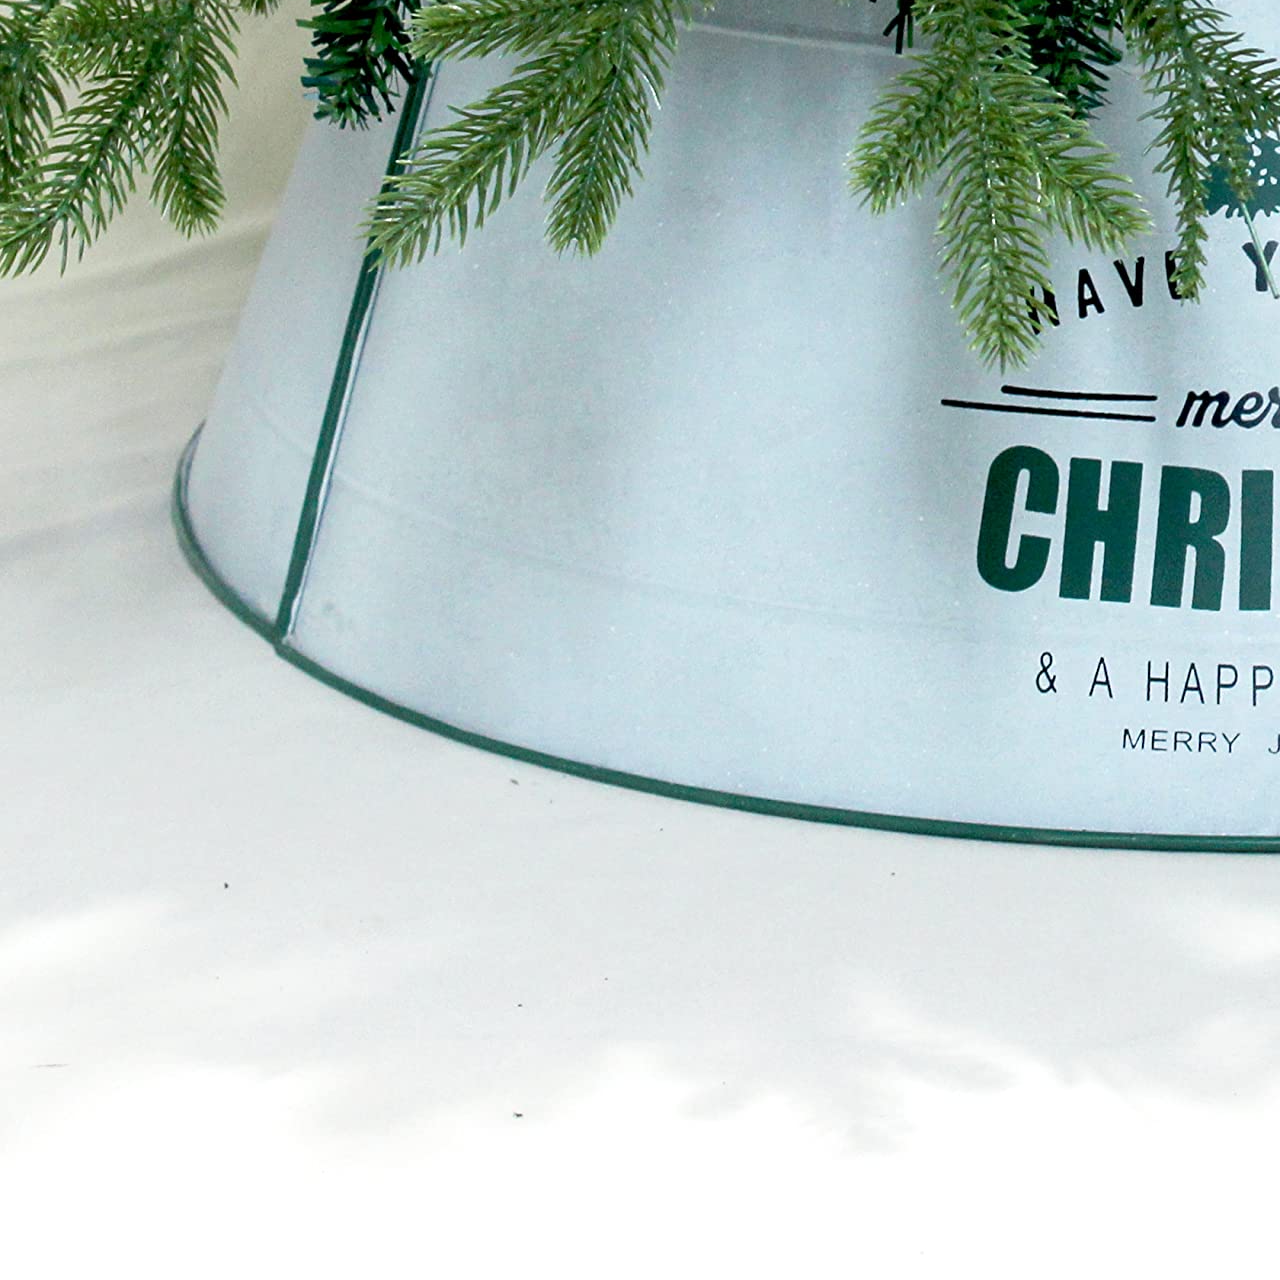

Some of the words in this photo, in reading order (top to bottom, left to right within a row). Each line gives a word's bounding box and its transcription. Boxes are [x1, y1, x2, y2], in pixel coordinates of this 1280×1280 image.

[1035, 650, 1058, 694] &
[1088, 656, 1114, 700] A
[1122, 727, 1241, 754] MERRY
